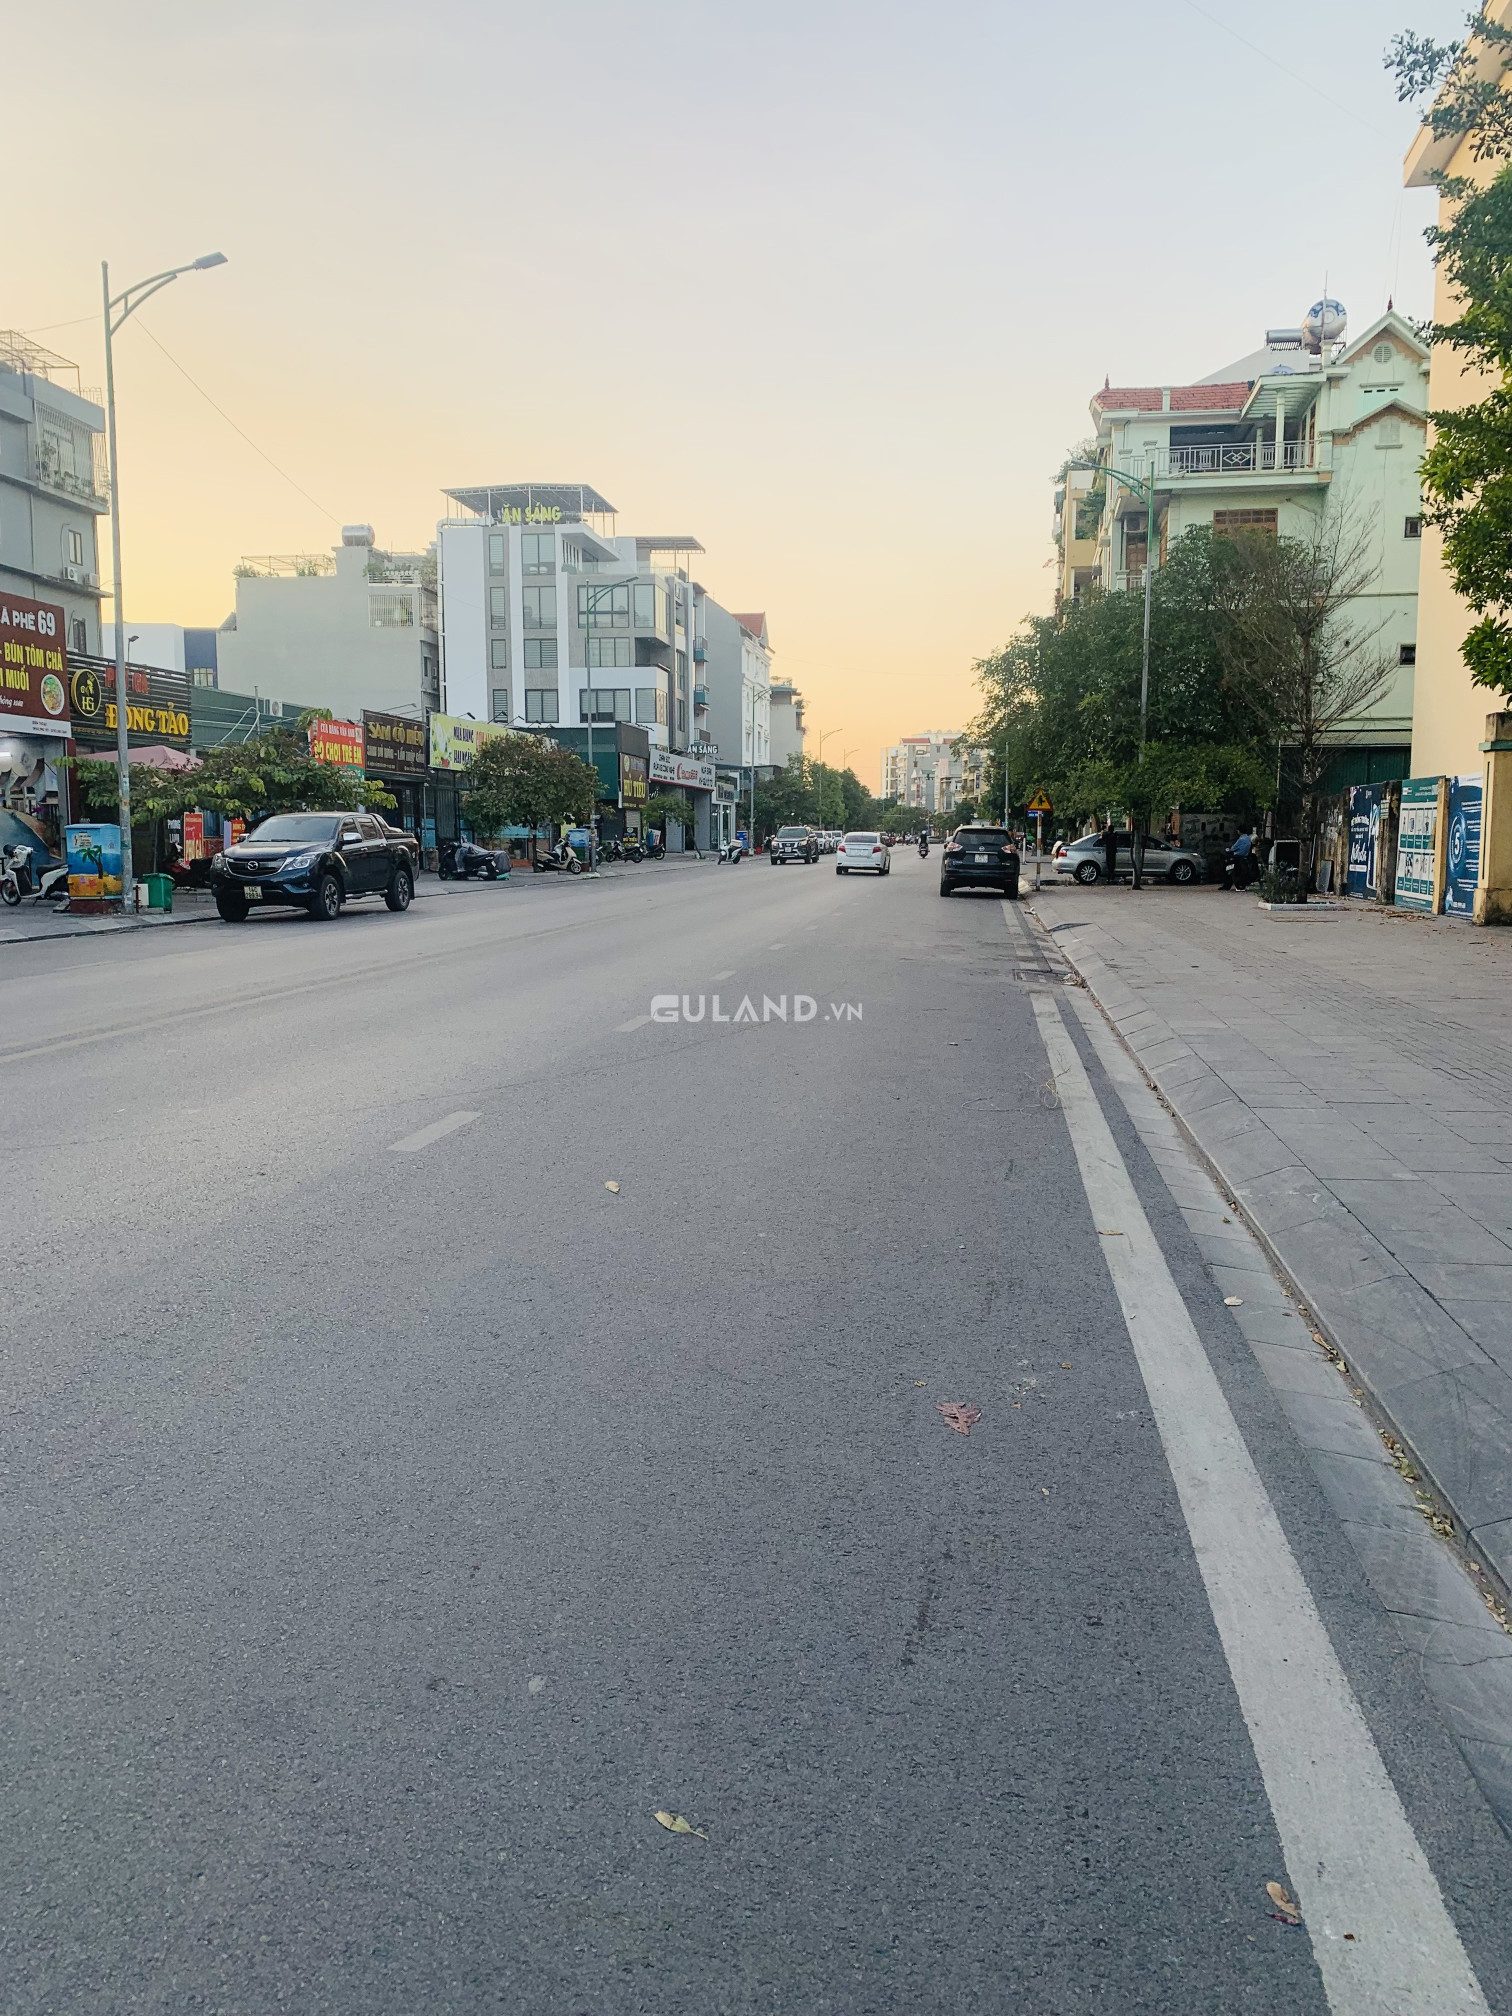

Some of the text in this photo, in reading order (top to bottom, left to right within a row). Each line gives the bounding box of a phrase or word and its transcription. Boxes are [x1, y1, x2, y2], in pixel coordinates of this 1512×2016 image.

[525, 502, 561, 522] SÁNG
[12, 610, 36, 631] PHÊ
[37, 610, 56, 636] 69
[4, 639, 63, 671] BÚN TÔM CHẢ
[5, 665, 30, 691] MUỐI
[155, 702, 189, 736] TẢO
